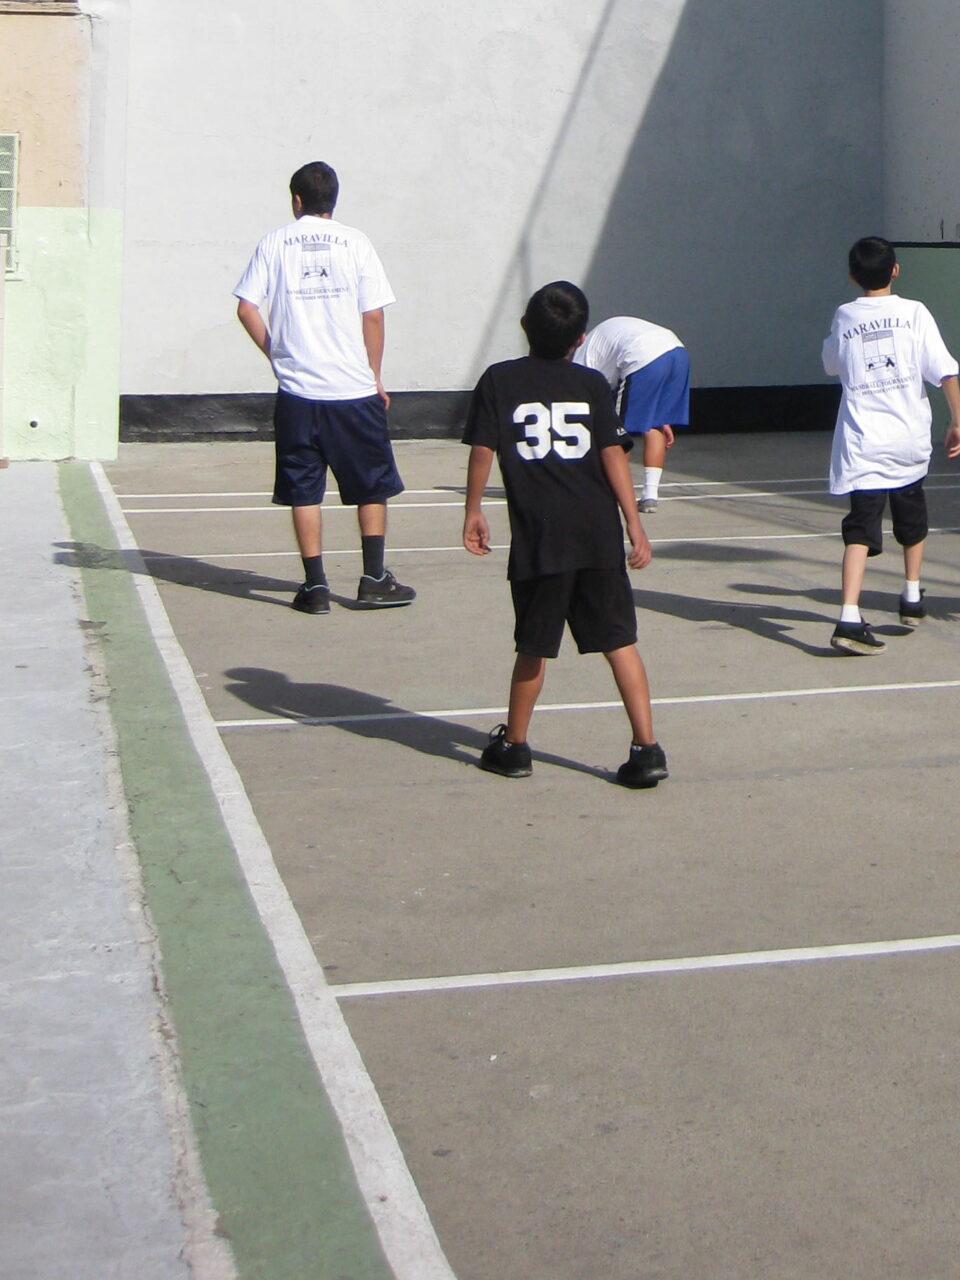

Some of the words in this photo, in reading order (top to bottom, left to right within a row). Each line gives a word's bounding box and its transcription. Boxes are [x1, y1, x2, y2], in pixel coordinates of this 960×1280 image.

[283, 233, 348, 248] MARAVILLA
[842, 317, 911, 343] MARAVILLA
[512, 401, 592, 461] 35
